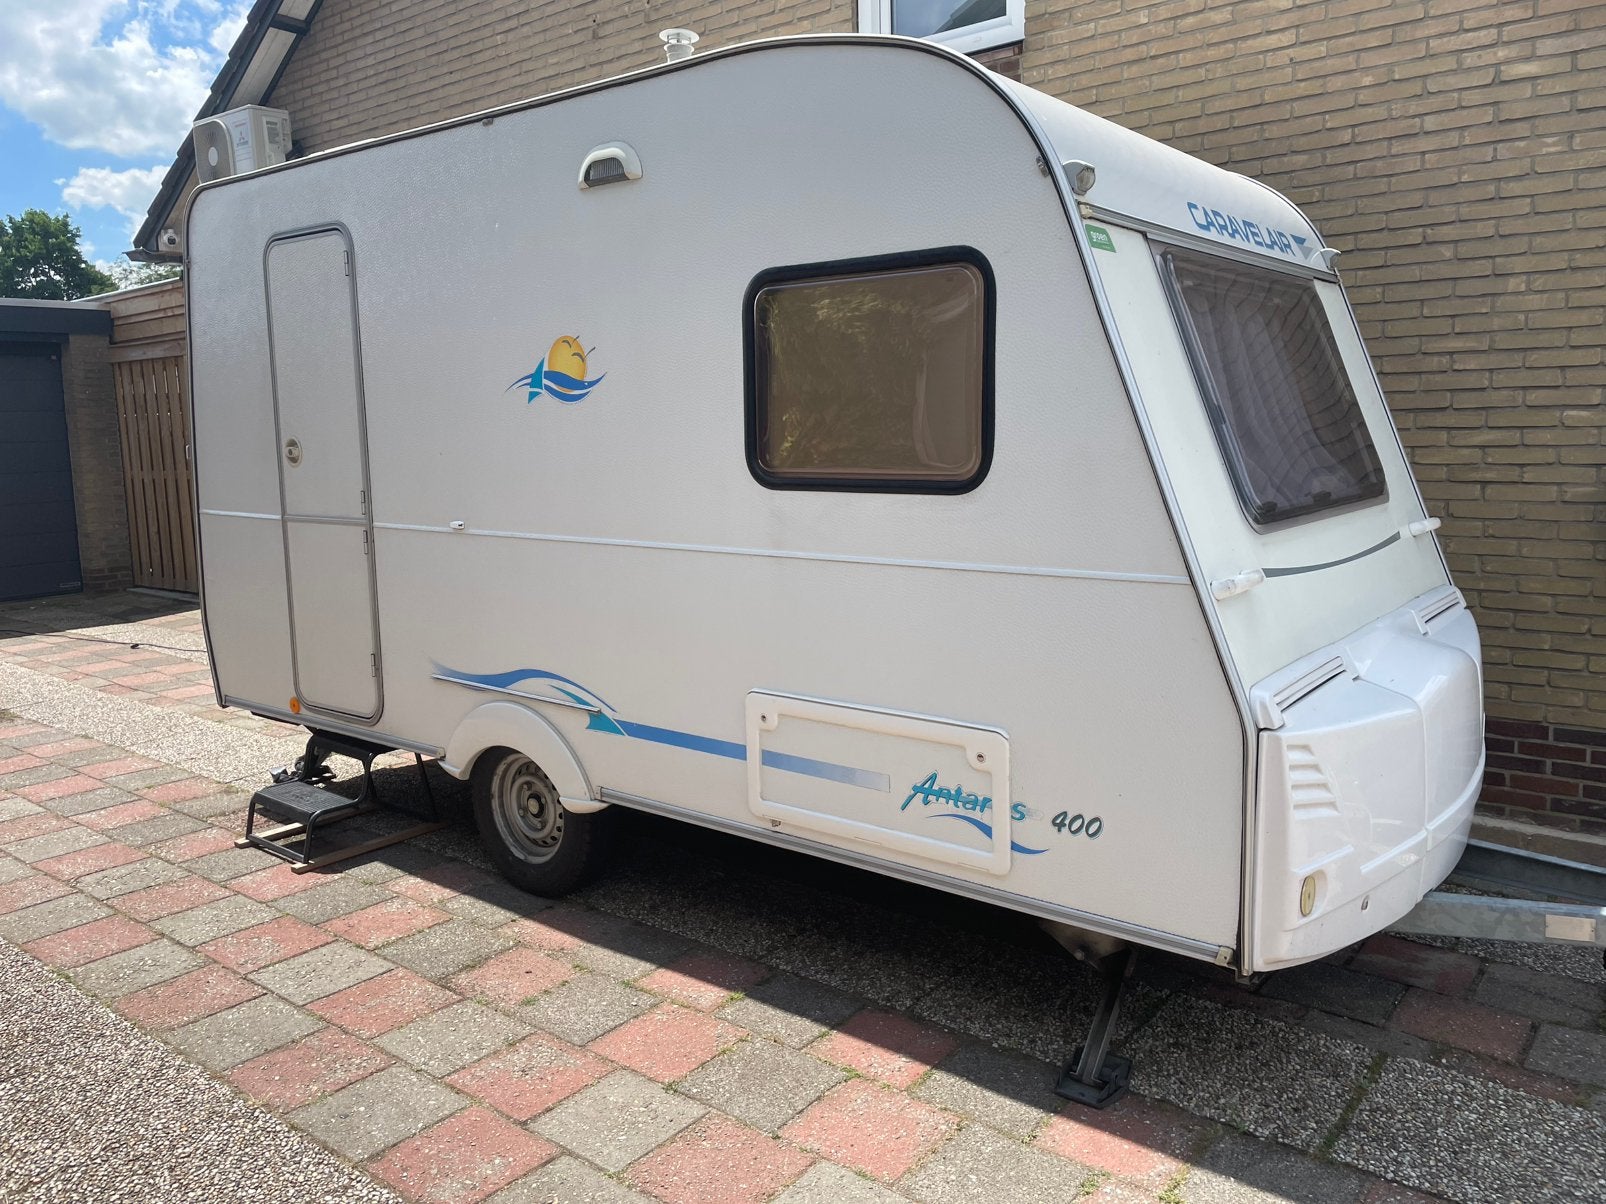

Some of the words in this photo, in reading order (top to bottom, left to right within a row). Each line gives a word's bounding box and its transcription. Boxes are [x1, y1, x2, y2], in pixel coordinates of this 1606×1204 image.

[1187, 201, 1296, 257] CARAVELAIR
[901, 771, 1026, 821] Antars
[1051, 811, 1103, 839] 400
